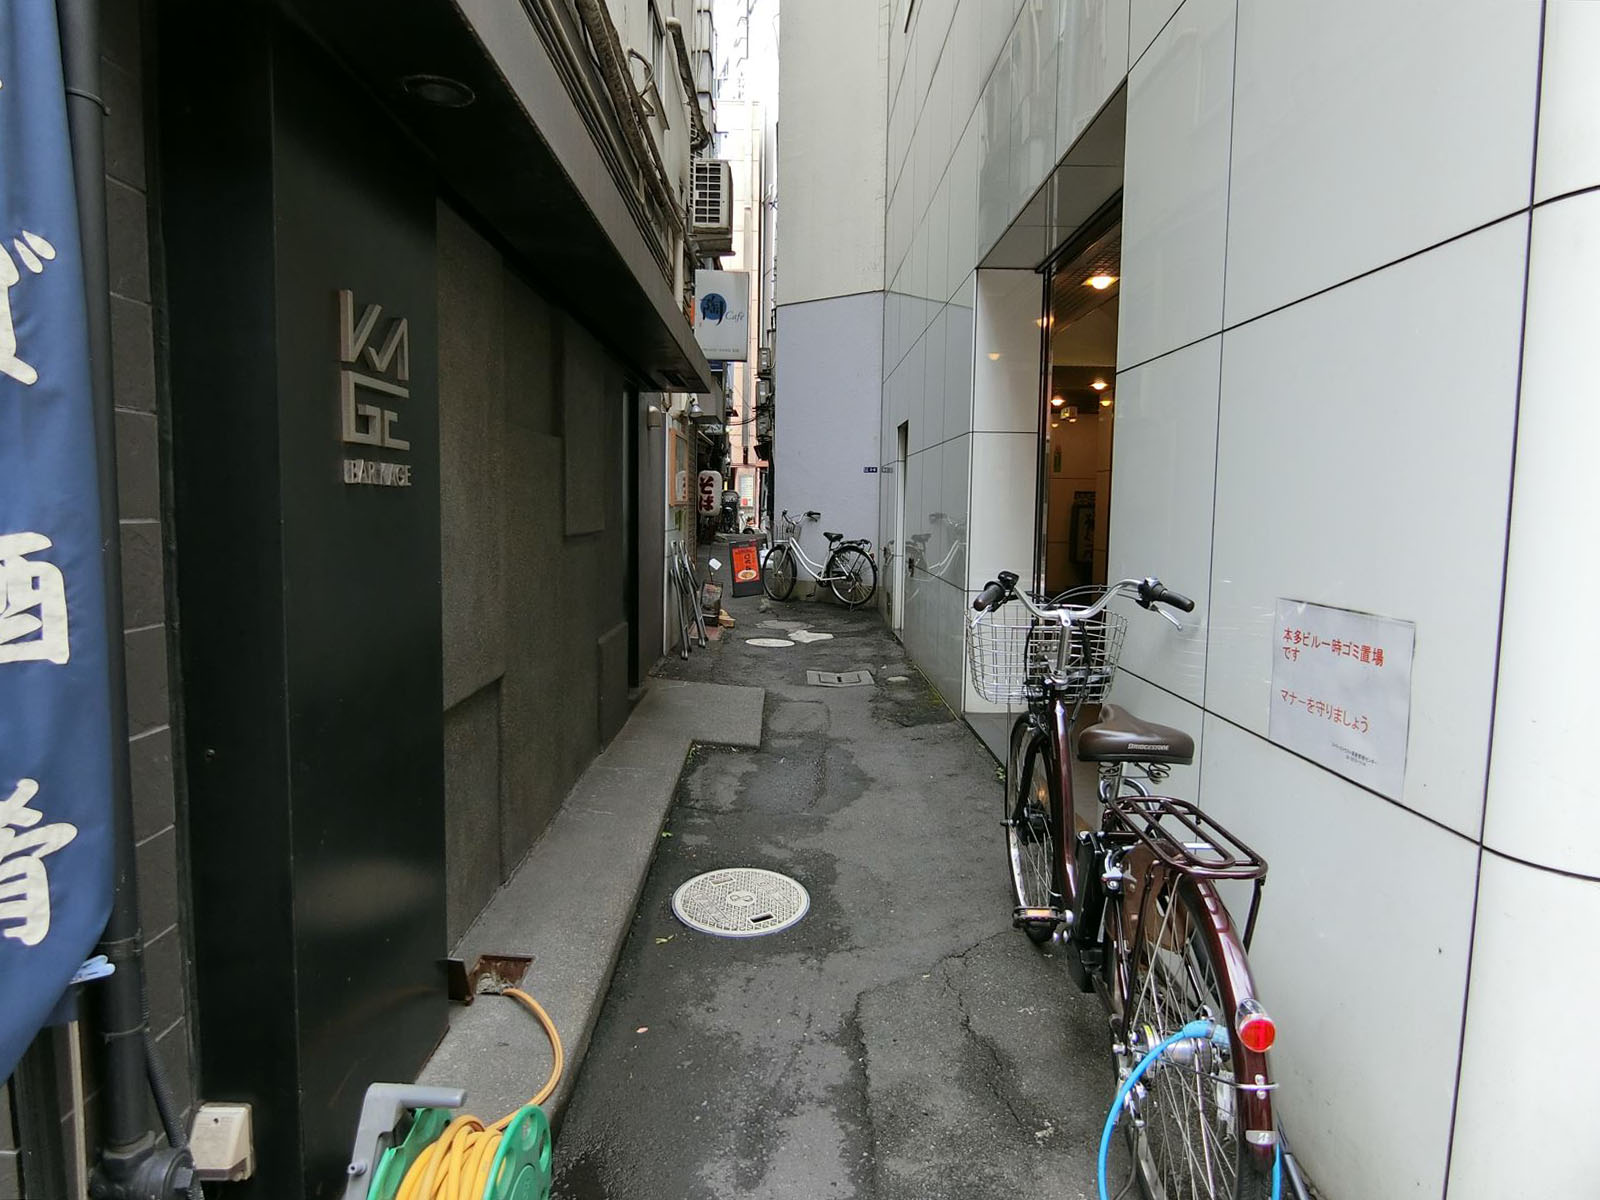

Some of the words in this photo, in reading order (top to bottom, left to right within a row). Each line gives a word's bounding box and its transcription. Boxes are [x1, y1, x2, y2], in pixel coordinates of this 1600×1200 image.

[344, 459, 377, 484] BAR
[699, 475, 715, 511] そば
[1282, 626, 1384, 667] 本多ビル一時ゴミ置場
[1282, 646, 1300, 662] です
[1280, 689, 1369, 733] マナーを守りましょう
